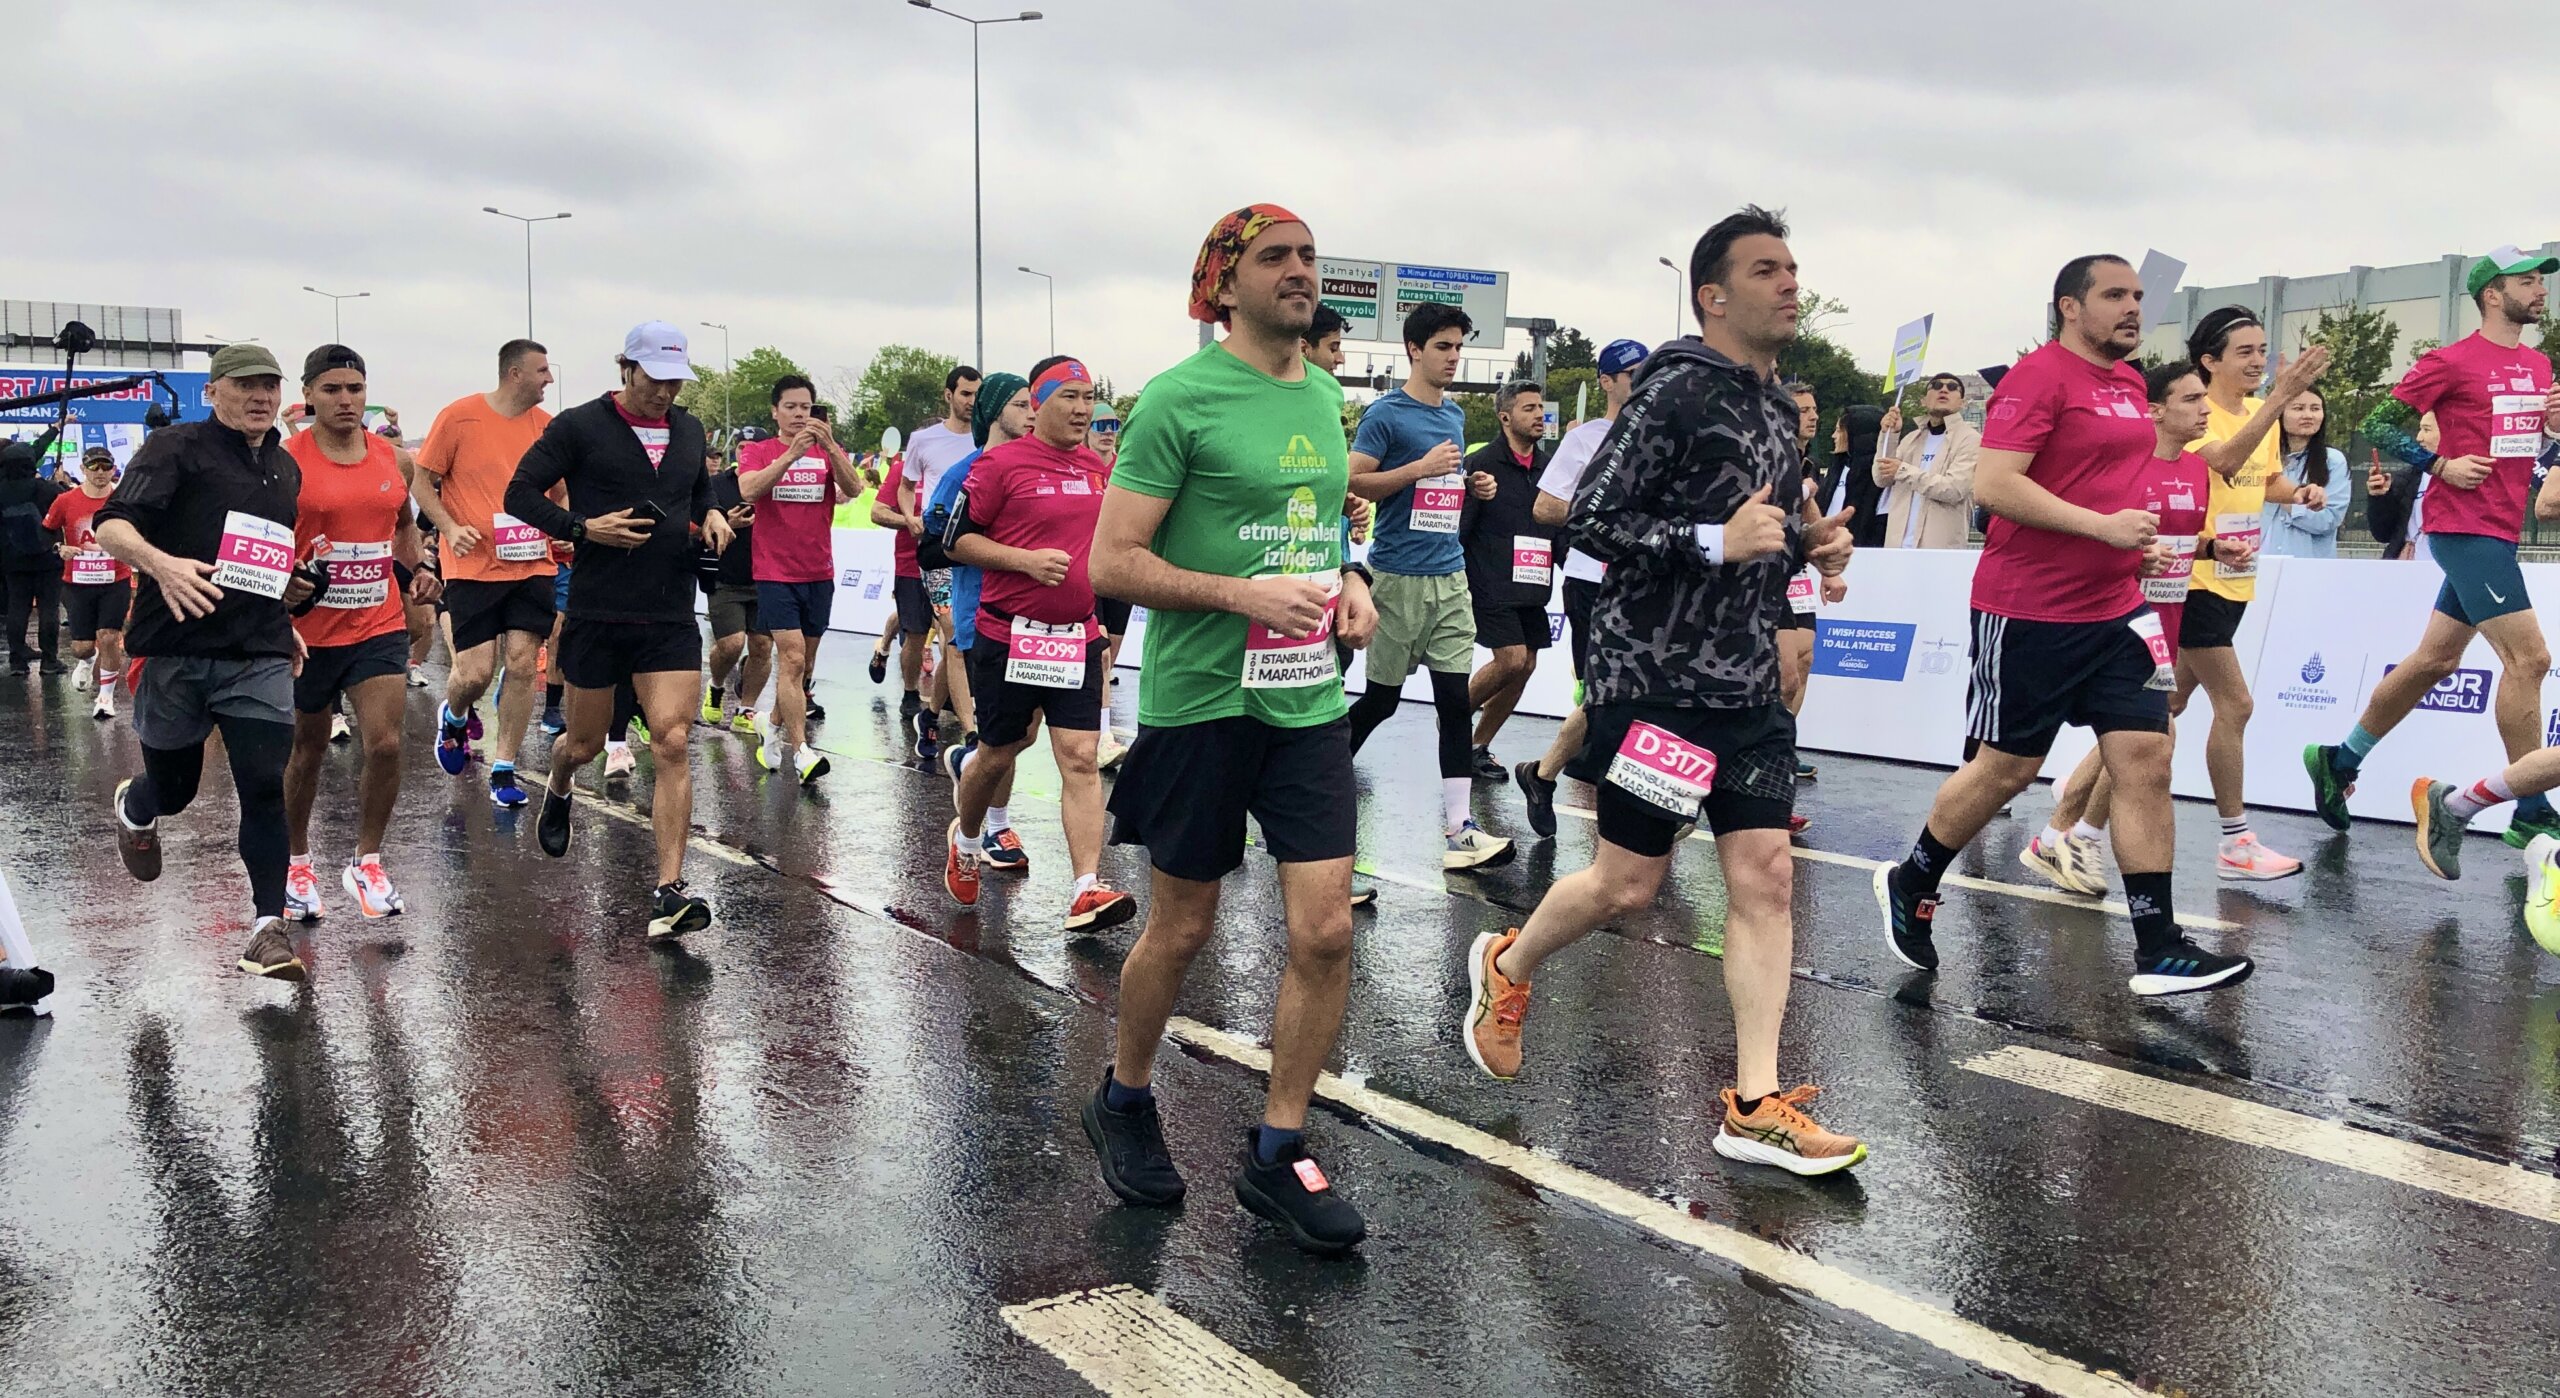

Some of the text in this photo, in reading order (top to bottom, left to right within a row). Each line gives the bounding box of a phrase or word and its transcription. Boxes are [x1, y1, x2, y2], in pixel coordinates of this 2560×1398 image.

[1322, 264, 1373, 279] Samatya
[1407, 268, 1428, 277] Mimar
[1428, 270, 1445, 279] Kadir
[1323, 281, 1376, 295] Yedikule
[1398, 290, 1434, 300] Avrasya
[1643, 382, 1664, 404] NIKE
[1627, 404, 1647, 430] NIKE
[2503, 415, 2541, 431] B 1527
[1613, 431, 1633, 457] NIKE
[781, 471, 817, 483] A 888
[1600, 459, 1618, 486] NIKE
[1424, 491, 1459, 508] C 2611
[1586, 487, 1605, 512] NIKE
[1287, 497, 1317, 520] Pes
[1417, 519, 1452, 530] MARATHON
[1585, 515, 1609, 534] NKE
[506, 527, 540, 540] A 693
[233, 538, 288, 568] F 5793
[1520, 552, 1529, 563] C
[87, 562, 107, 570] 1165
[227, 564, 278, 583] ISTANBUL HALF
[340, 564, 382, 580] 4365
[223, 573, 277, 594] MARATHON
[357, 586, 373, 595] HALF
[321, 595, 372, 605] MARATHON
[1827, 627, 1897, 640] I WISH SUCCESS
[1018, 638, 1079, 659] C 2099
[1822, 639, 1896, 652] TO ALL ATHLETES
[1261, 649, 1327, 664] ISTANBUL HALF
[1017, 662, 1066, 674] ISTANBUL HALF
[1258, 665, 1324, 681] MARATHON
[1016, 671, 1066, 684] MARATHON
[1634, 728, 1661, 755] D
[1659, 741, 1716, 782] 3177
[1621, 760, 1667, 790] ISTANBUL
[1666, 782, 1692, 798] HALF
[1616, 773, 1685, 812] MARATHON
